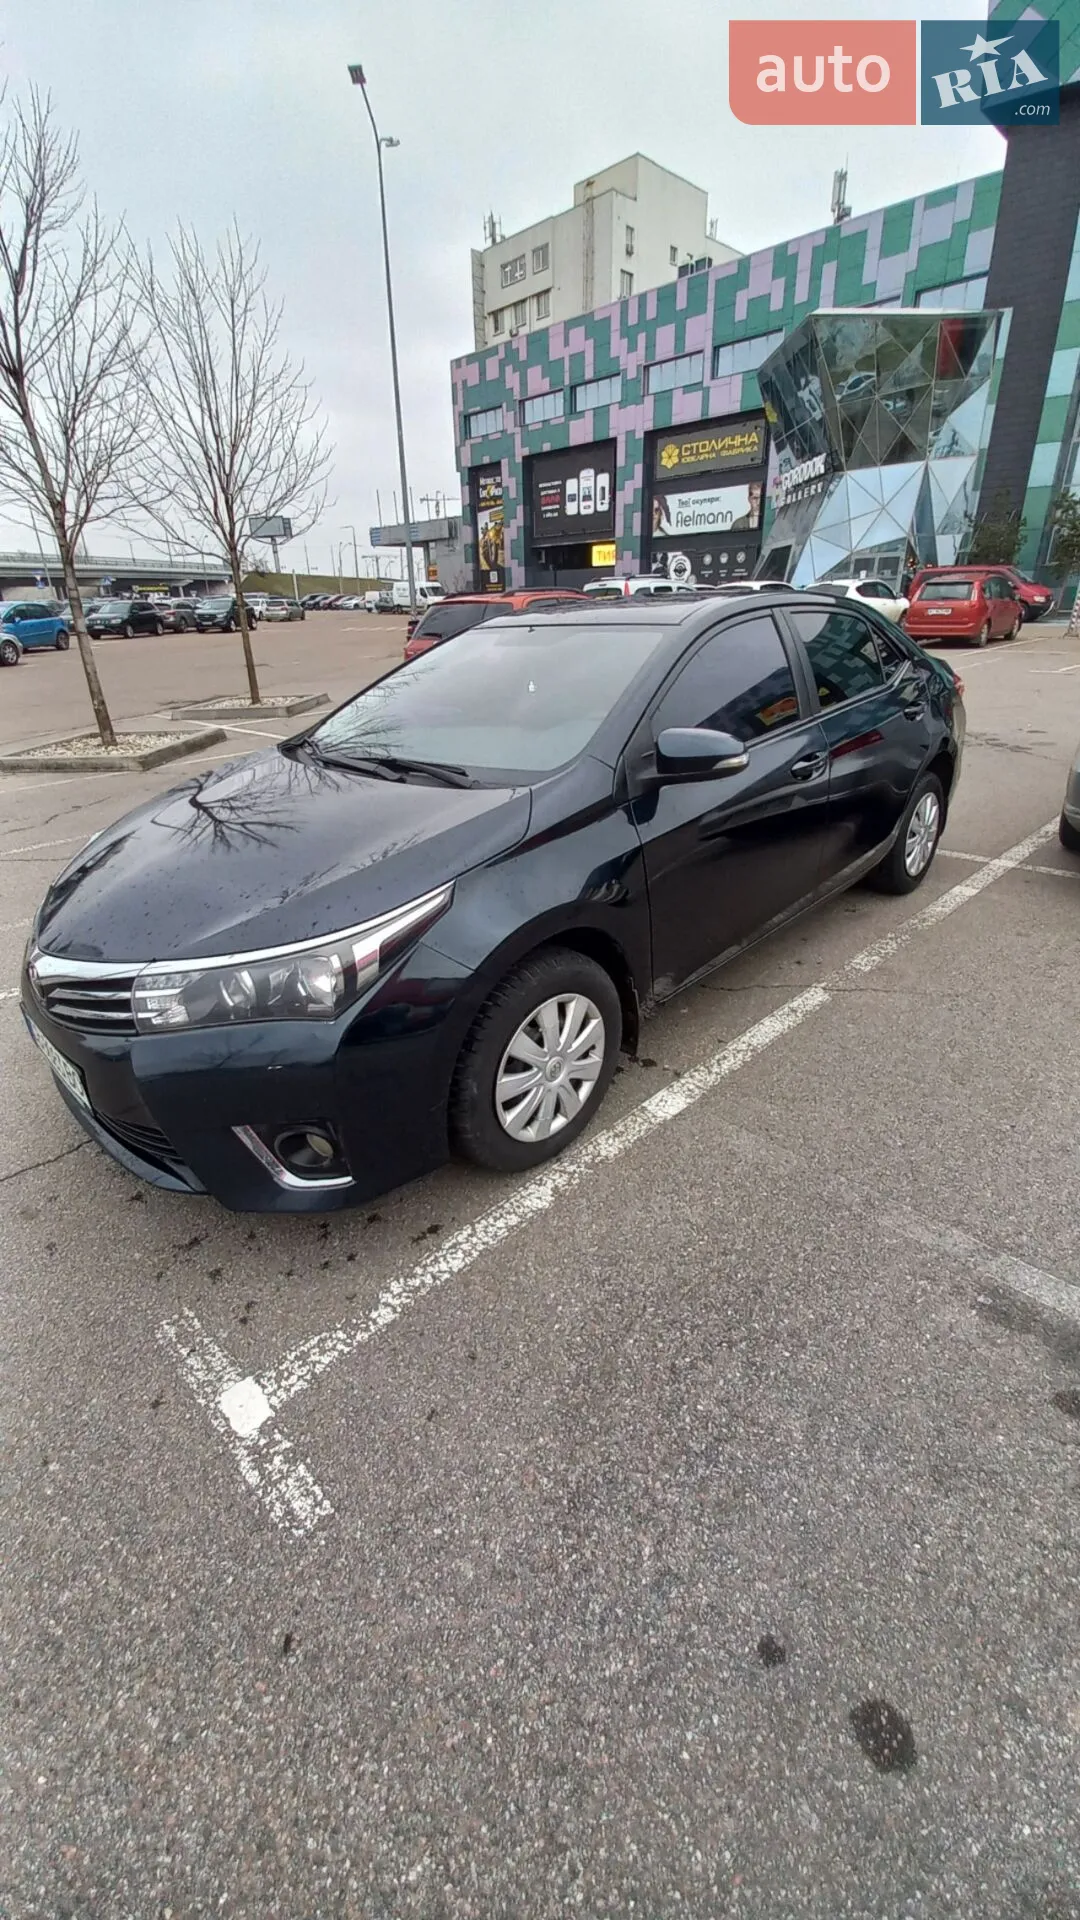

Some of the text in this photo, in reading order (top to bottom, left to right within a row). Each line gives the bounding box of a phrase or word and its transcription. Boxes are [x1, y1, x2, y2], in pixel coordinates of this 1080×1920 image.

[681, 432, 758, 455] СТОЛИЧНА
[720, 446, 758, 457] ФАБРИКА
[781, 453, 826, 490] GORODOK
